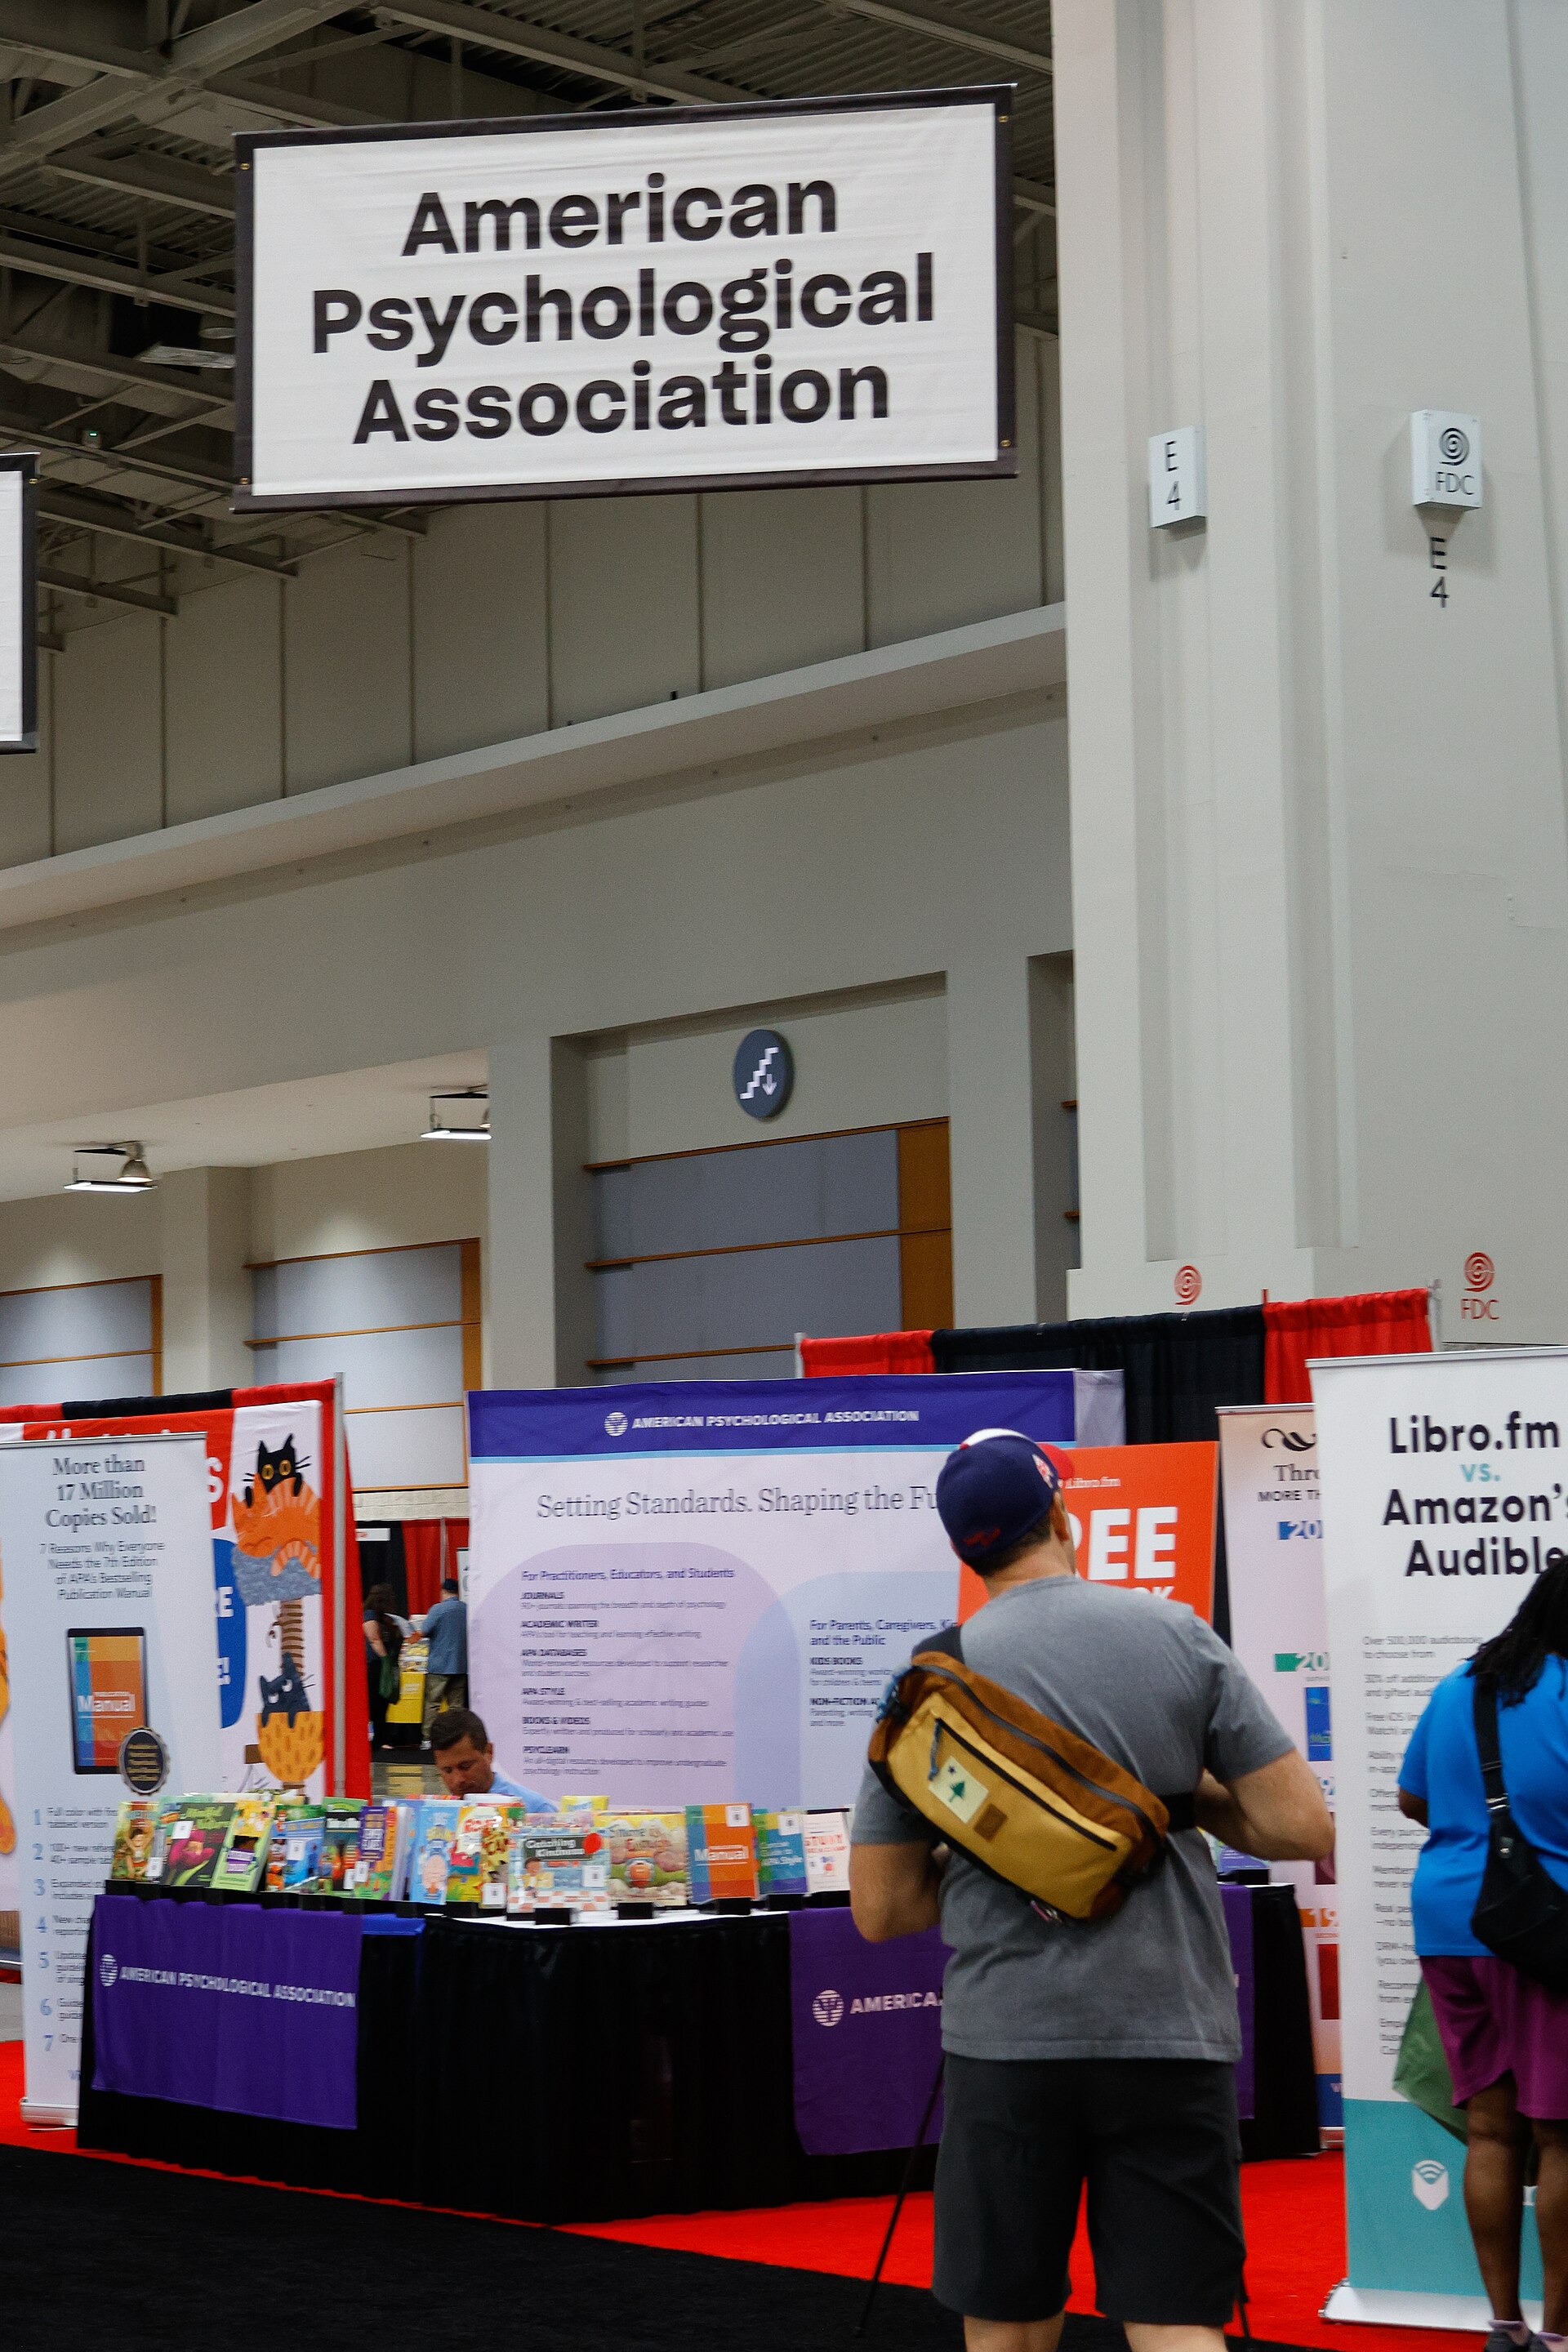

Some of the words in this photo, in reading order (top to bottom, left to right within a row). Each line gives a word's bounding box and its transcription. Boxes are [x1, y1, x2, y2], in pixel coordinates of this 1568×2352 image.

[401, 172, 837, 256] American
[312, 252, 934, 368] Psychological
[352, 354, 890, 444] Association
[1165, 440, 1178, 472] E
[1436, 471, 1475, 496] FDC
[1166, 480, 1182, 510] 4
[1430, 537, 1447, 570] E
[1429, 577, 1450, 608] 4
[1461, 1298, 1499, 1321] FDC
[631, 1415, 704, 1429] AMERICAN
[706, 1412, 822, 1428] PSYCHOLOGICAL
[824, 1410, 920, 1424] ASSOCIATION
[1390, 1410, 1560, 1454] Libro.fm
[51, 1457, 100, 1475] More
[104, 1454, 145, 1473] than
[1461, 1463, 1501, 1482] vs.
[57, 1484, 75, 1501] 17
[80, 1480, 145, 1500] Million
[1258, 1490, 1301, 1503] MORE
[537, 1494, 621, 1521] Setting
[626, 1488, 752, 1516] Standards.
[758, 1486, 859, 1517] Shaping
[864, 1485, 903, 1511] the
[46, 1508, 107, 1533] Copies
[111, 1504, 157, 1525] Sold!
[50, 1541, 91, 1554] Reasons
[94, 1541, 115, 1554] Why
[118, 1541, 165, 1554] Everyone
[122, 1557, 158, 1568] Edition
[521, 1569, 537, 1580] For
[666, 1569, 684, 1580] and
[688, 1569, 735, 1580] Students
[809, 1619, 826, 1631] For
[809, 1634, 829, 1646] and
[832, 1634, 850, 1646] the
[853, 1634, 886, 1646] Public
[78, 1694, 136, 1712] Manual
[32, 1843, 44, 1860] 2
[694, 1846, 749, 1861] Manual
[33, 1878, 46, 1896] 3
[36, 1916, 48, 1933] 4
[39, 1951, 50, 1969] 5
[119, 1967, 177, 1985] AMERICAN
[177, 1971, 272, 1998] PSYCHOLOGICAL
[273, 1984, 356, 2007] ASSOCIATION
[40, 1998, 52, 2016] 6
[44, 2034, 54, 2052] 7
